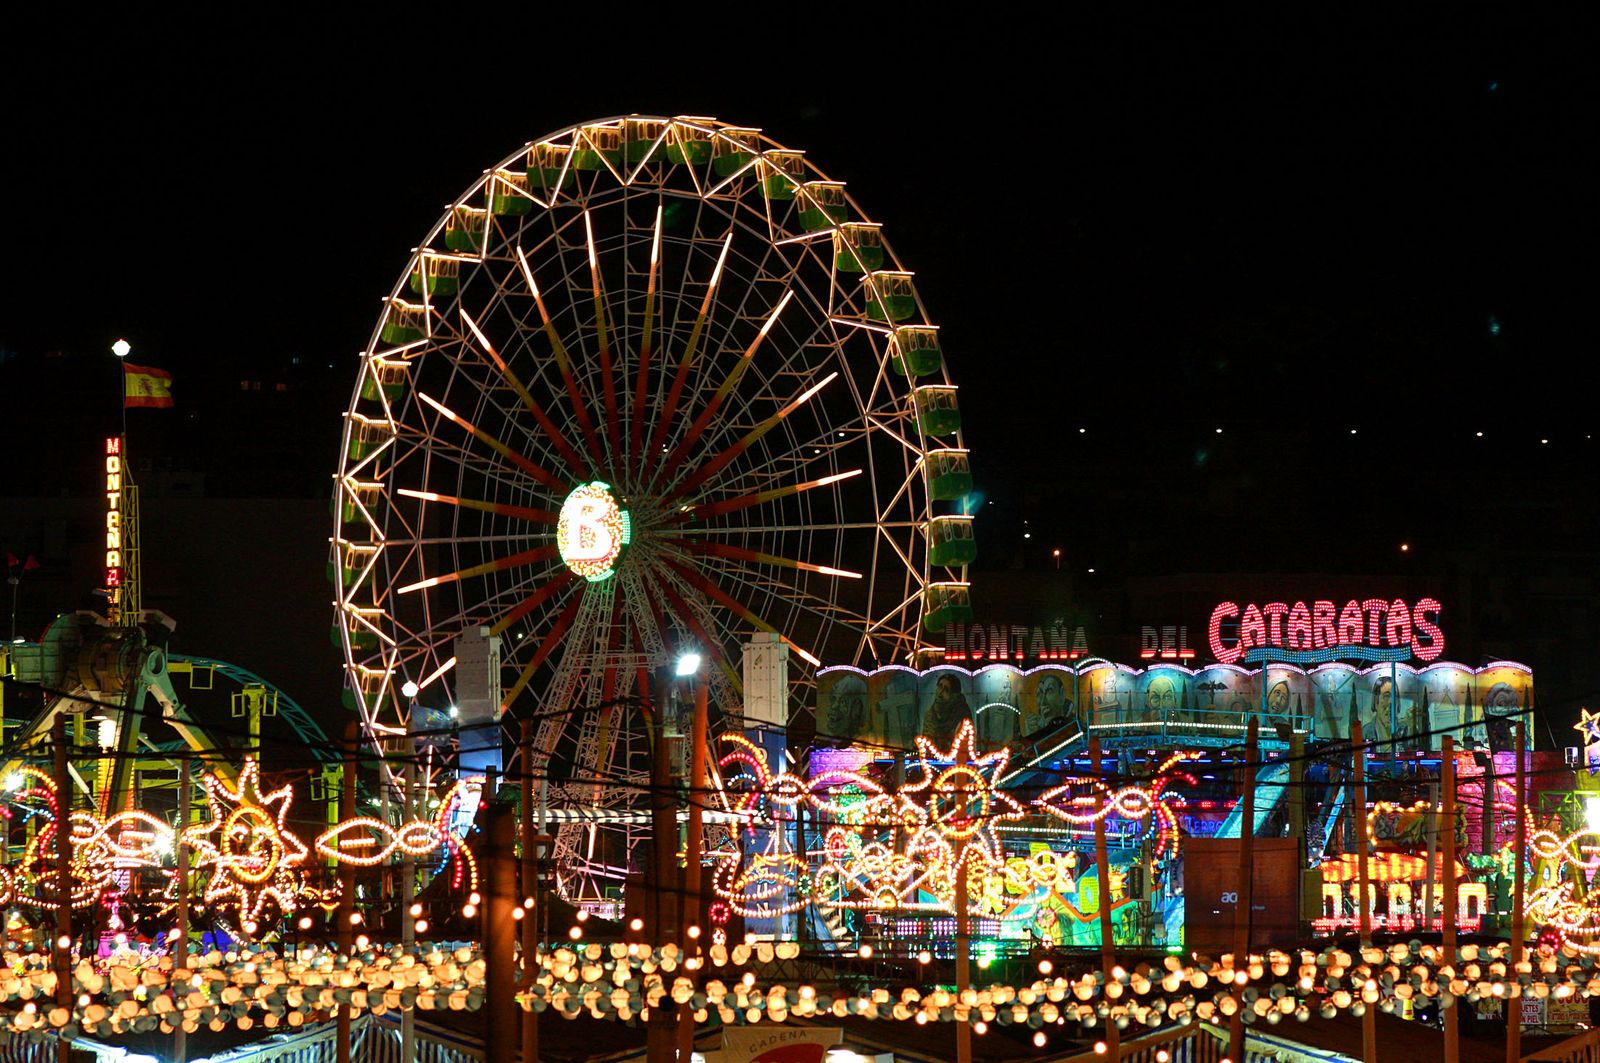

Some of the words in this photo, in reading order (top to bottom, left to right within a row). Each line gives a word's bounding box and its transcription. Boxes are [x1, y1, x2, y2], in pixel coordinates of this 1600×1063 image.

[106, 437, 121, 568] MONTAÑA
[563, 494, 614, 561] B
[945, 617, 1088, 660] MONTAÑA
[1141, 626, 1195, 658] DEL
[1208, 597, 1445, 664] CATARATAS
[749, 1029, 807, 1053] CADENA
